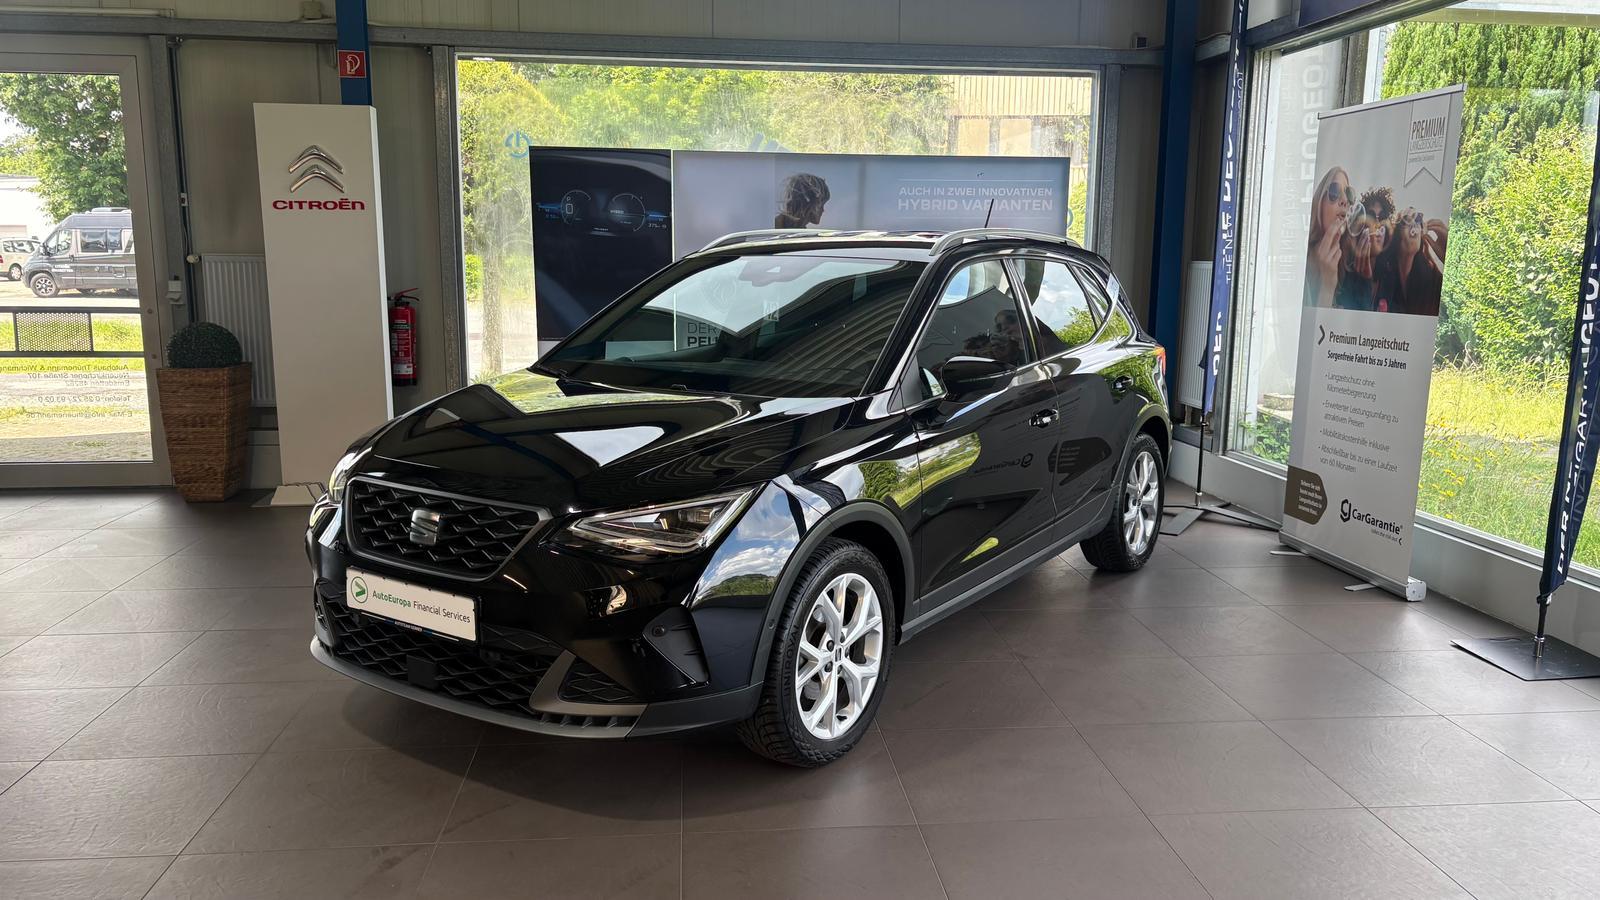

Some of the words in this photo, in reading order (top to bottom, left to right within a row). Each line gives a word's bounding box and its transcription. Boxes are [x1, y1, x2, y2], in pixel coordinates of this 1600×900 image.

[1411, 116, 1446, 140] PREMIUM
[900, 187, 931, 196] AUCH
[933, 187, 945, 196] IN
[947, 187, 976, 196] ZWEI
[978, 187, 1053, 197] INNOVATIVEN
[898, 199, 958, 211] HYBRID
[961, 199, 1053, 211] VARIANTEN
[1328, 331, 1358, 346] Premium
[1358, 334, 1410, 352] Langzeitschutz
[1327, 350, 1355, 362] Sorgenfreie
[1354, 353, 1369, 365] Fahrt
[1369, 355, 1377, 366] bis
[1376, 359, 1384, 367] zu
[1383, 358, 1388, 367] 5
[1388, 358, 1407, 370] Jahren
[1352, 508, 1400, 535] CarGarantie
[372, 590, 412, 608] AutoEuropa
[413, 600, 441, 616] Financial
[442, 608, 471, 623] Services
